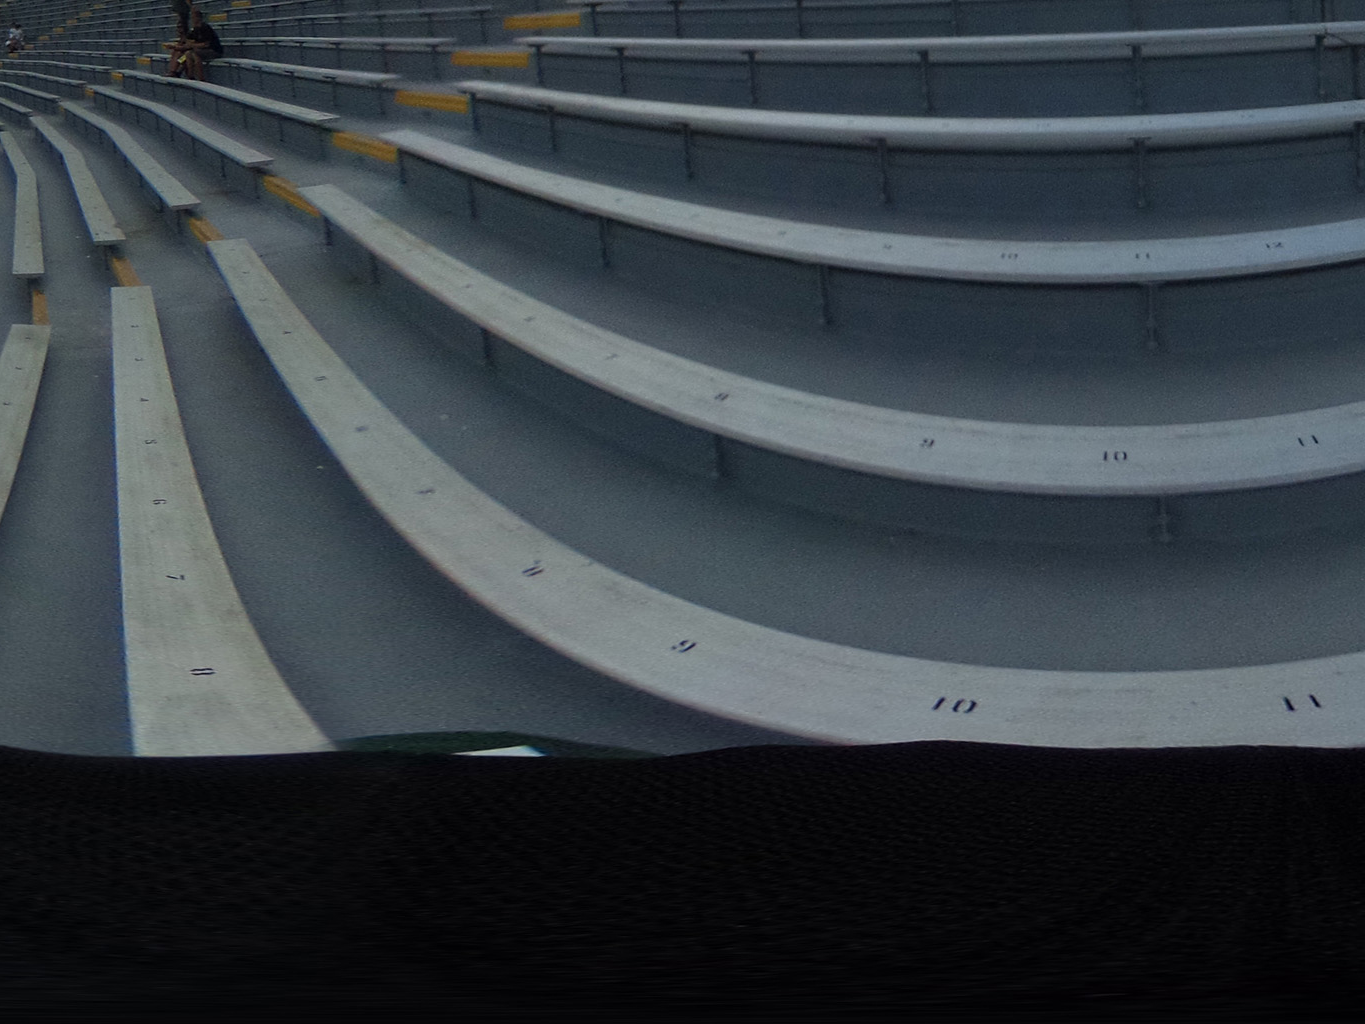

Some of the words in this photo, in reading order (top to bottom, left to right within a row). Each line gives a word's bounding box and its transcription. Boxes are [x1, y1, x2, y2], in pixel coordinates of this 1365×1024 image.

[1297, 434, 1320, 447] 11
[1103, 451, 1128, 462] 10
[670, 639, 697, 654] 9
[931, 696, 978, 715] 10
[1281, 693, 1323, 713] 11
